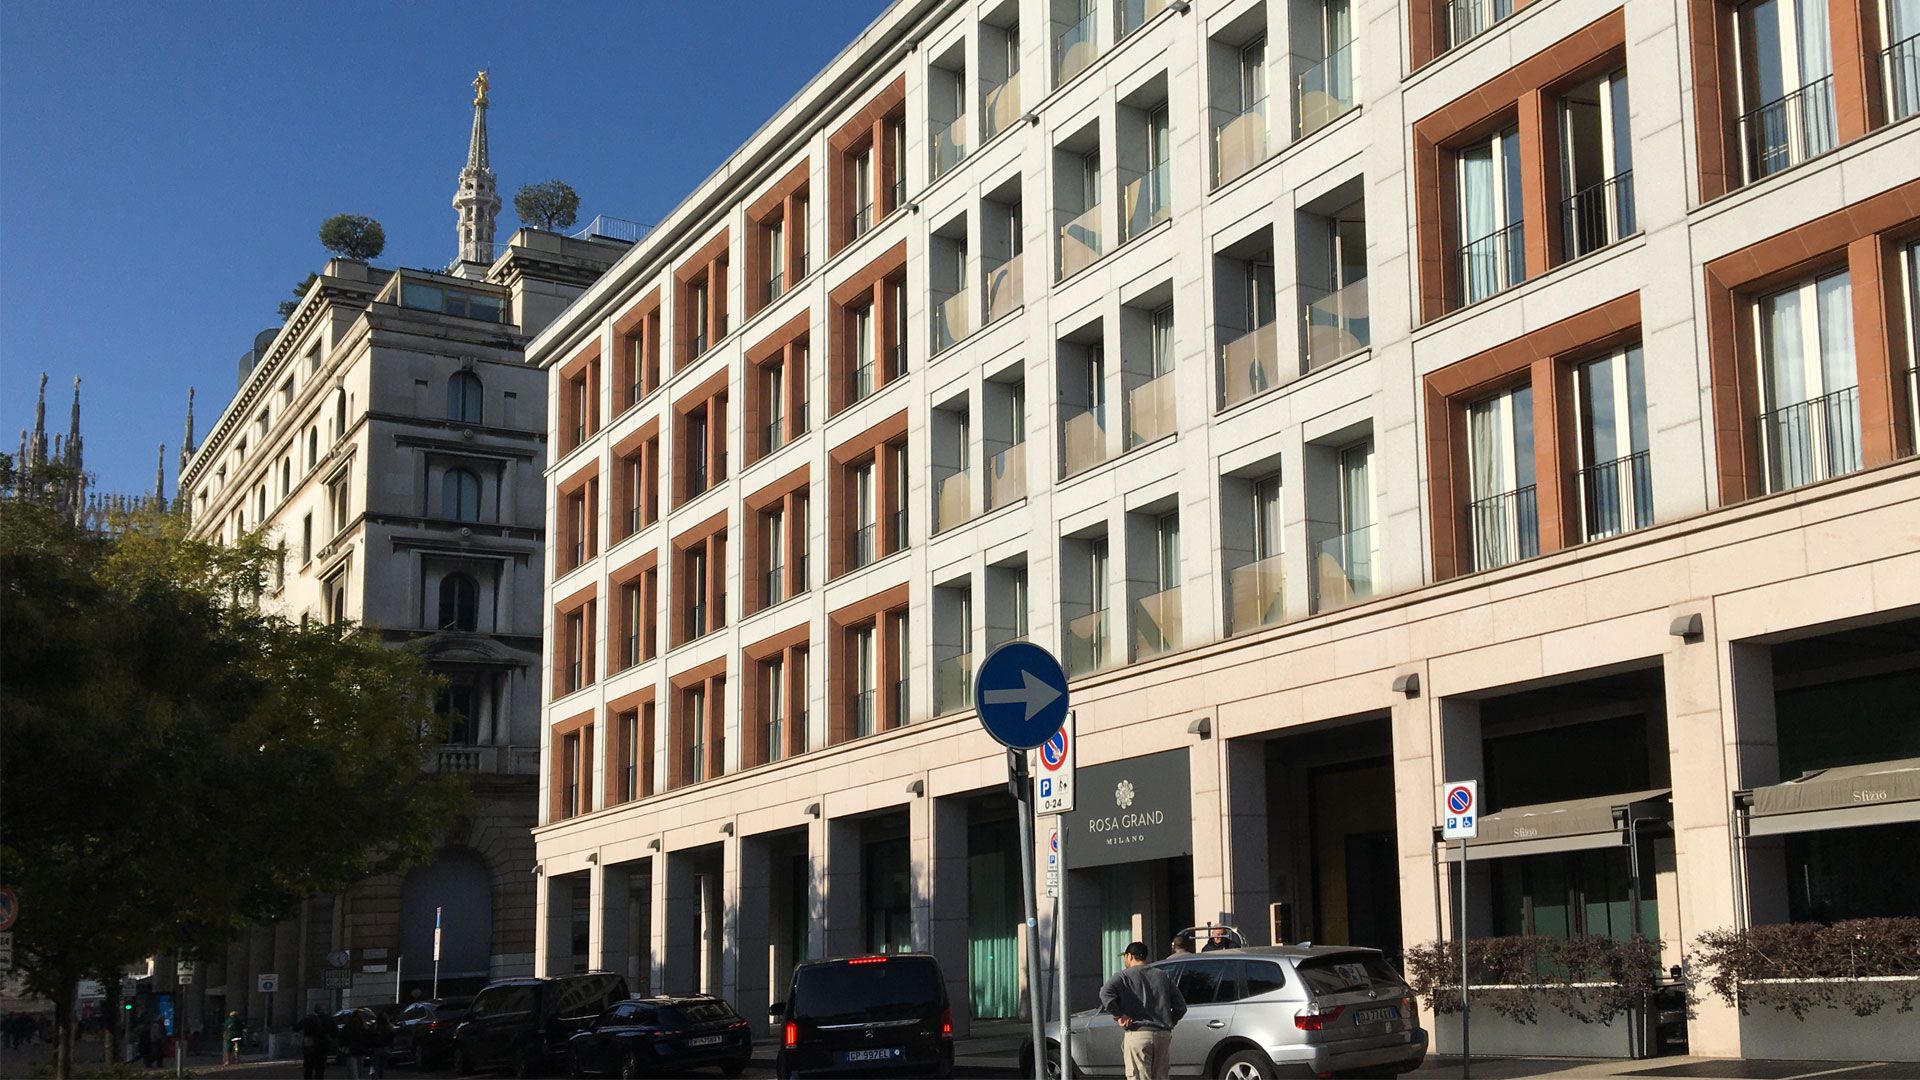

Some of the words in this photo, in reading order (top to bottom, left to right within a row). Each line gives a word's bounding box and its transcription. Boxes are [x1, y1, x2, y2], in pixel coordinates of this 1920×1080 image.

[1042, 780, 1050, 796] P
[1852, 789, 1887, 802] Sfizio
[1044, 798, 1062, 809] 0-24
[1089, 817, 1119, 833] ROSA
[1121, 810, 1164, 828] GRAND
[1106, 834, 1145, 845] MILANO
